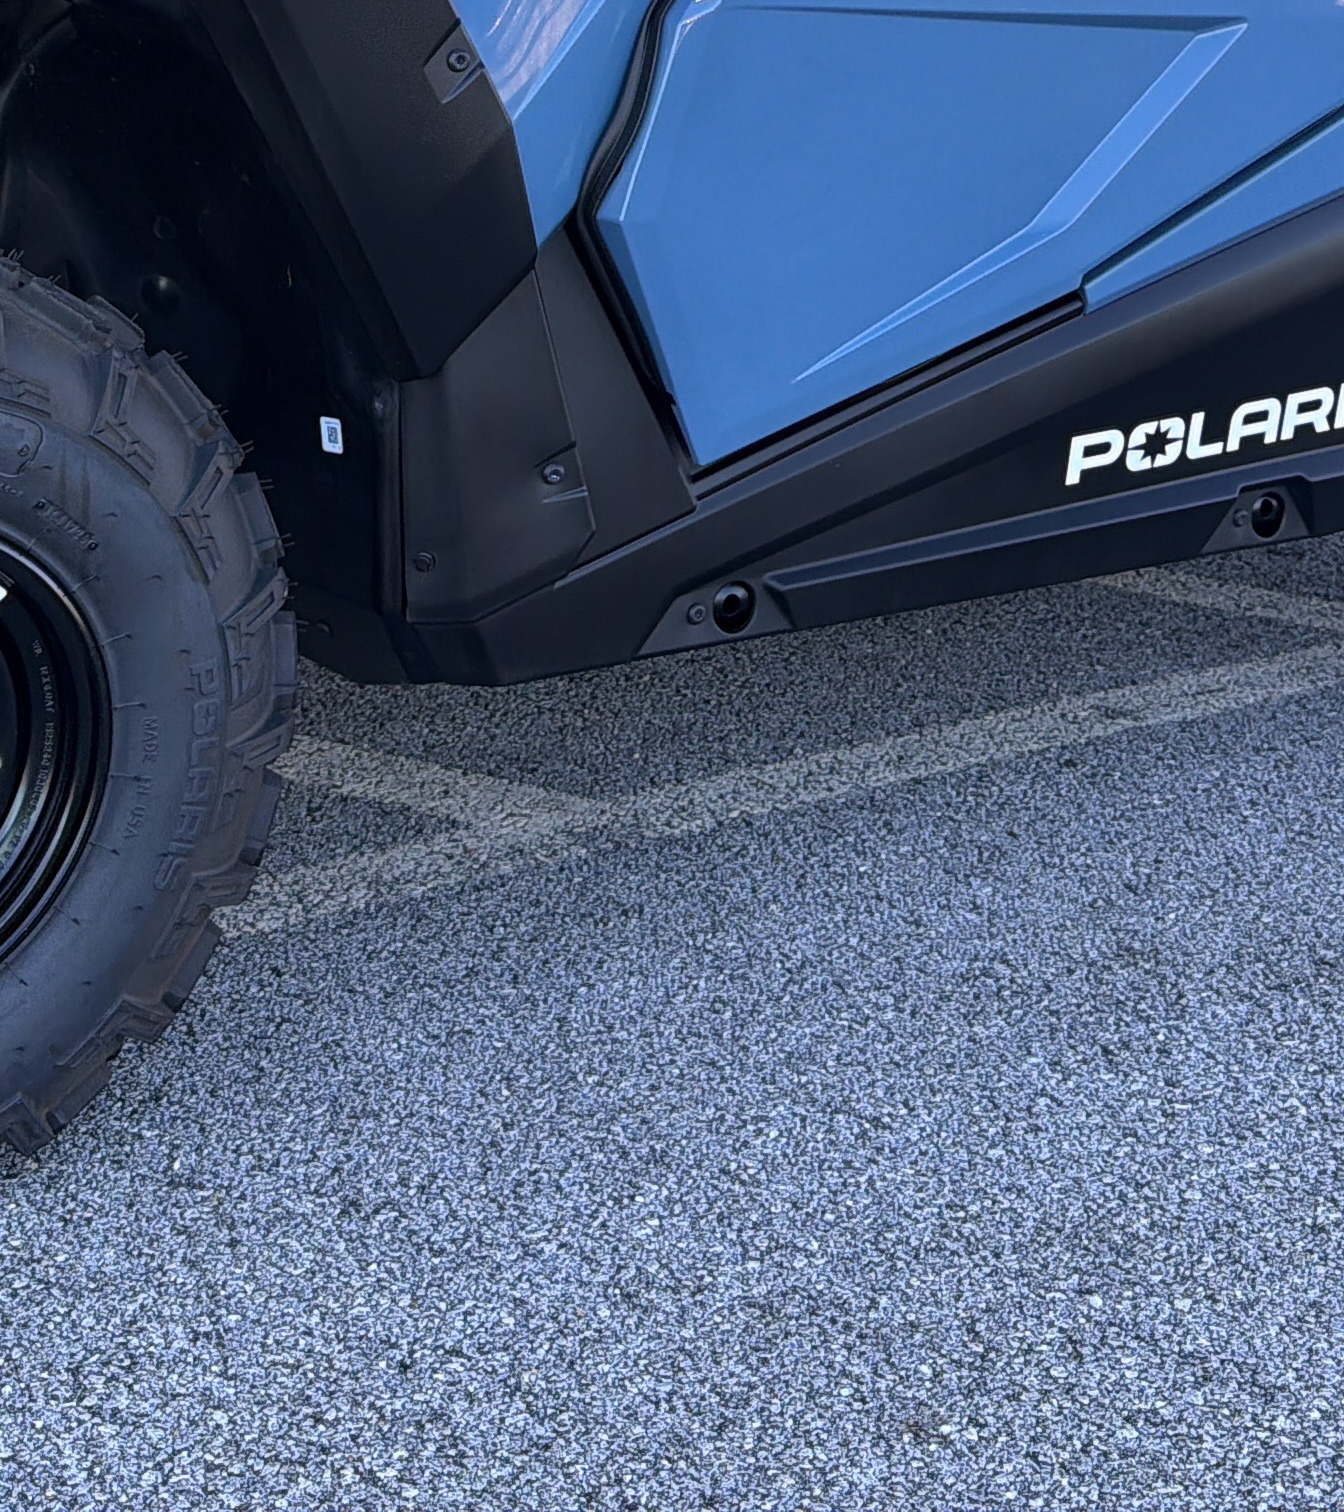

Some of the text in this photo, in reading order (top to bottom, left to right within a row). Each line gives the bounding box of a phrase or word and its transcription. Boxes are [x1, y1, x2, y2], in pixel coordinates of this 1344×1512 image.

[142, 715, 158, 765] MADE
[154, 658, 221, 890] POLARIS
[123, 805, 147, 840] USA
